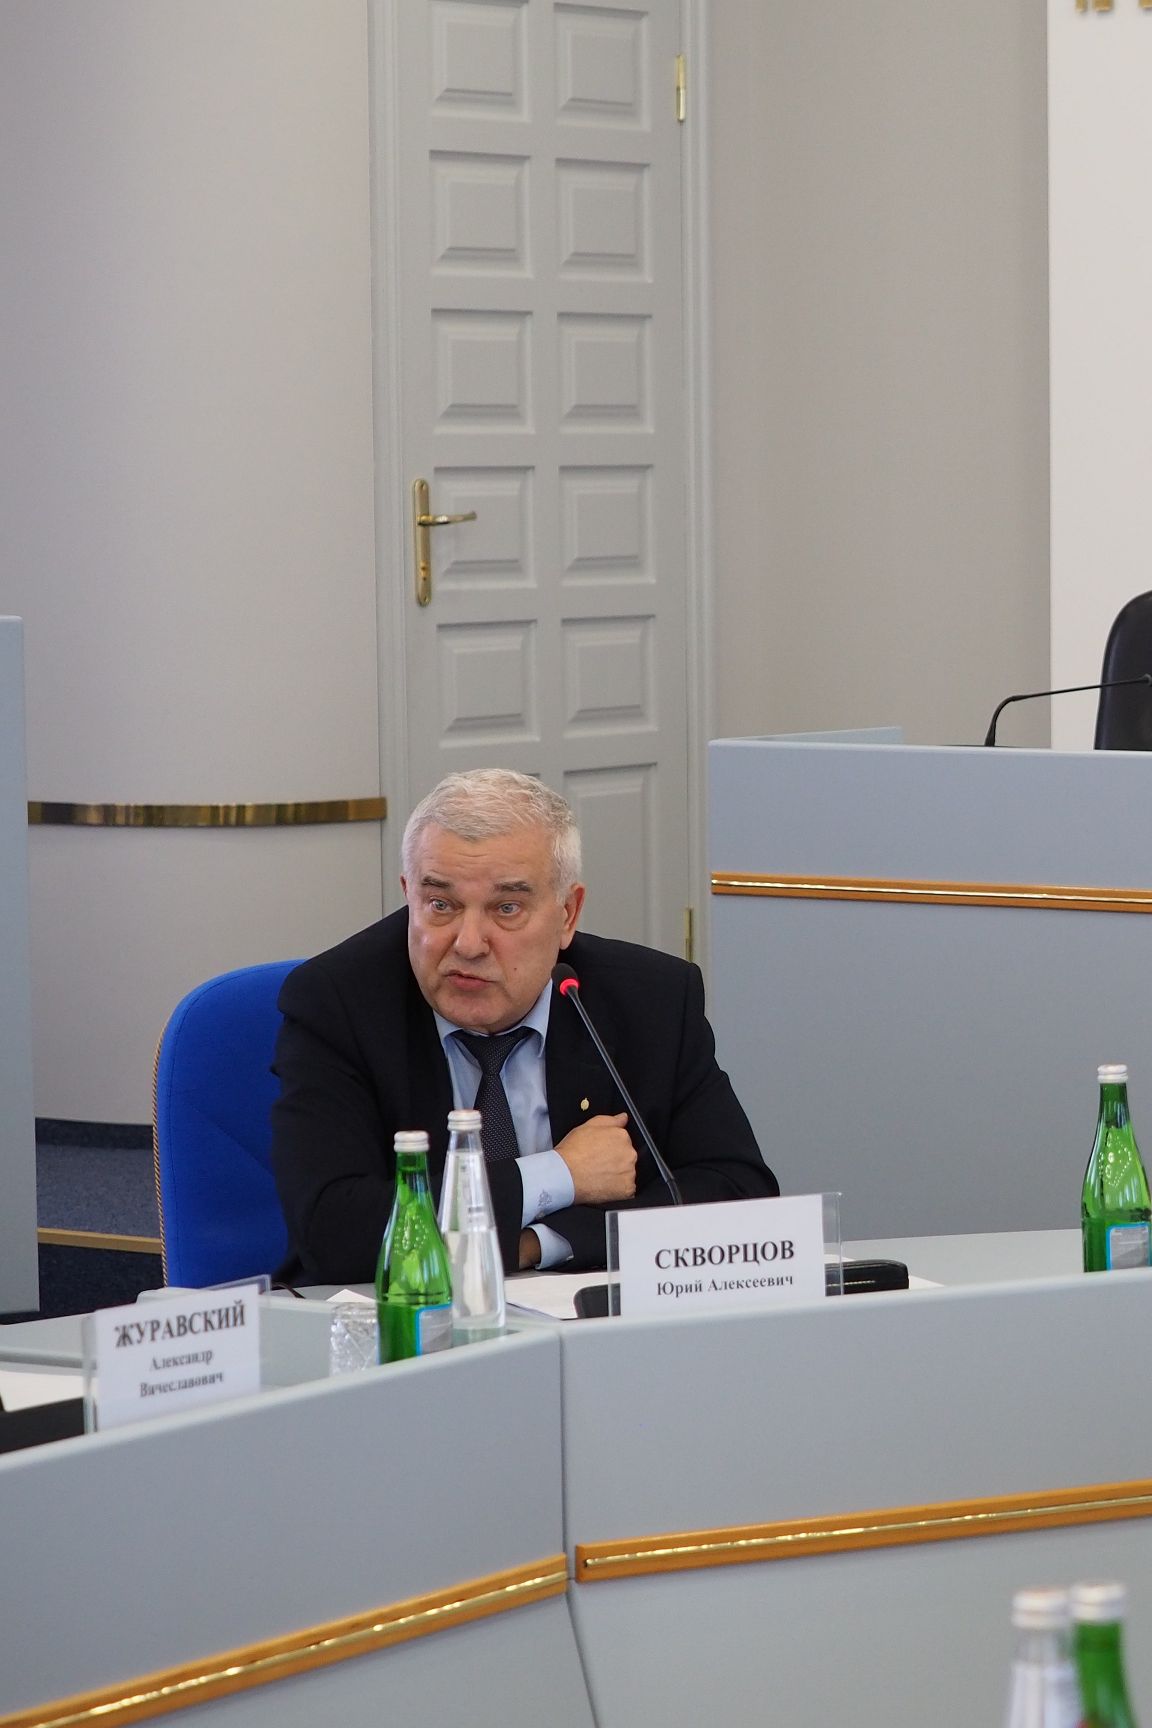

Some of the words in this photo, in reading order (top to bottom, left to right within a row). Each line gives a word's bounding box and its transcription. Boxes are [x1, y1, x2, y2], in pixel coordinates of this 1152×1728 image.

[655, 1239, 795, 1270] СКВОРЦОВ
[656, 1278, 703, 1298] Юрий
[708, 1274, 794, 1292] Алексеевич
[114, 1299, 246, 1349] ЖУРАВСКИЙ
[149, 1349, 214, 1371] Александр
[139, 1371, 224, 1398] Вячеславович
